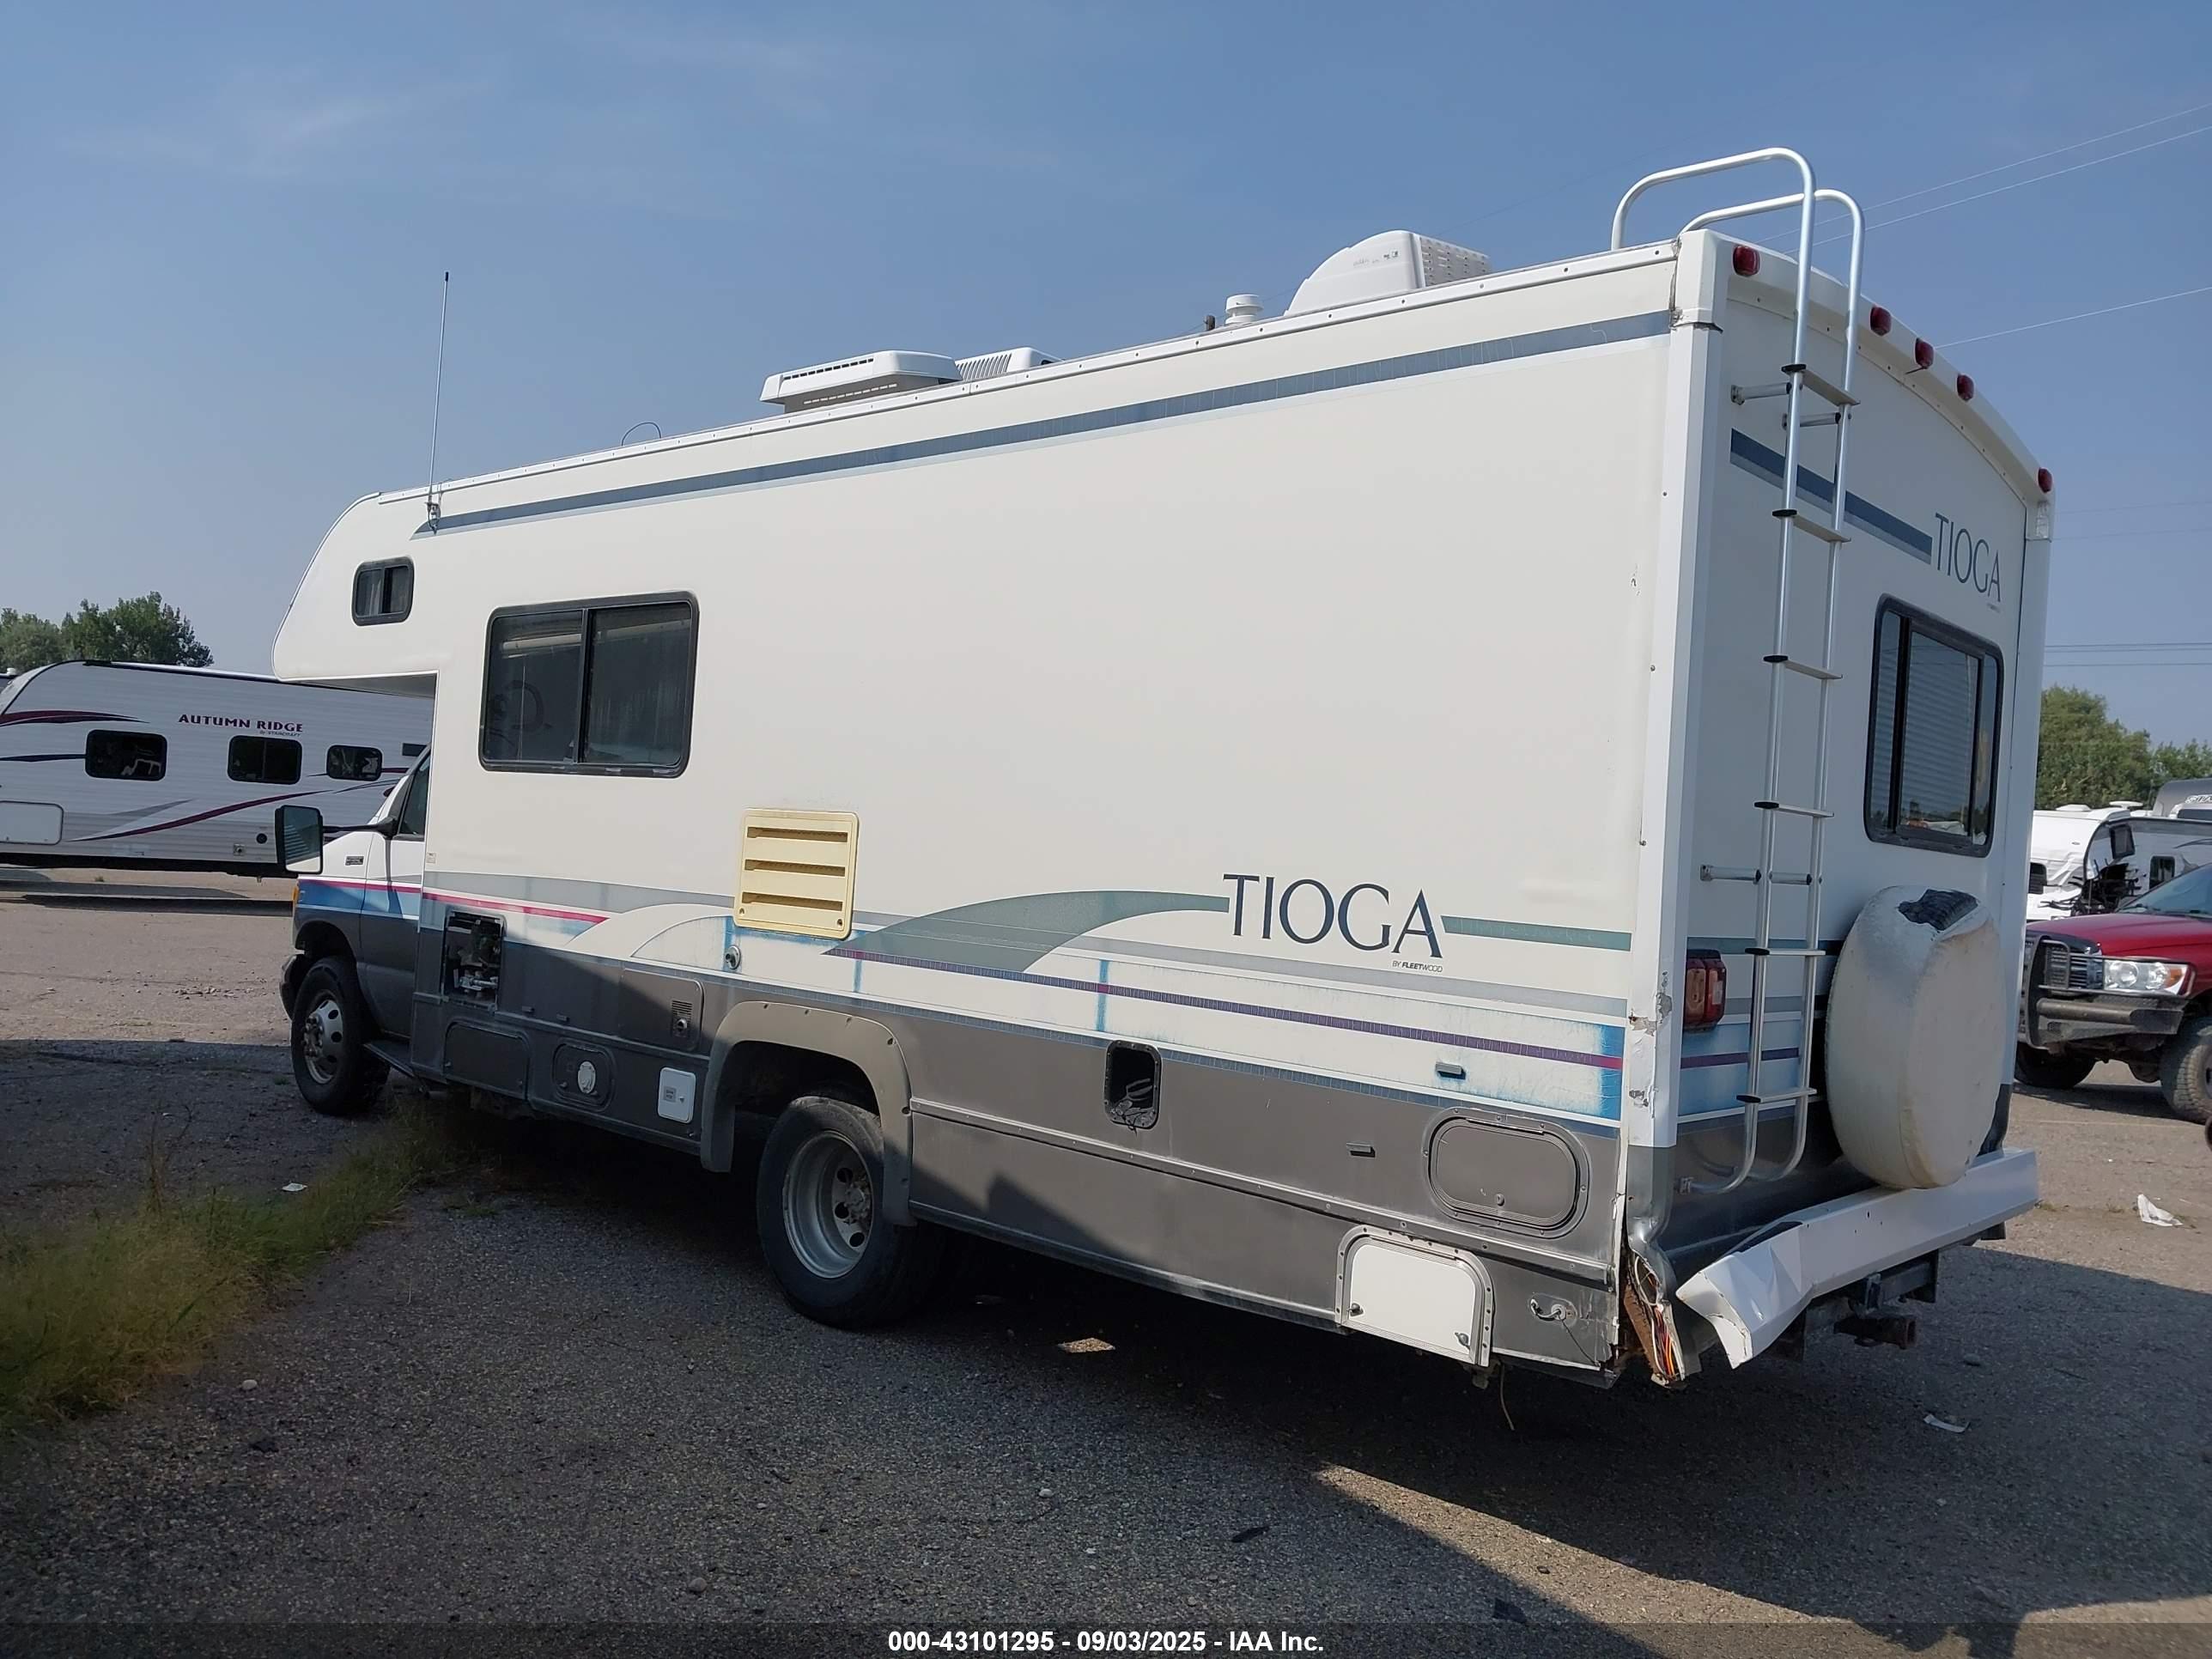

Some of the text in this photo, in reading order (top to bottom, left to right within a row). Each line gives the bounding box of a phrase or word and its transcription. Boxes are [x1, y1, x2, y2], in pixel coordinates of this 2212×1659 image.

[1936, 513, 2001, 602] TIOGA
[179, 714, 303, 732] AUTUMN RIDGE
[1223, 873, 1443, 959] TIOGA
[1401, 962, 1443, 973] FLEETWOOD
